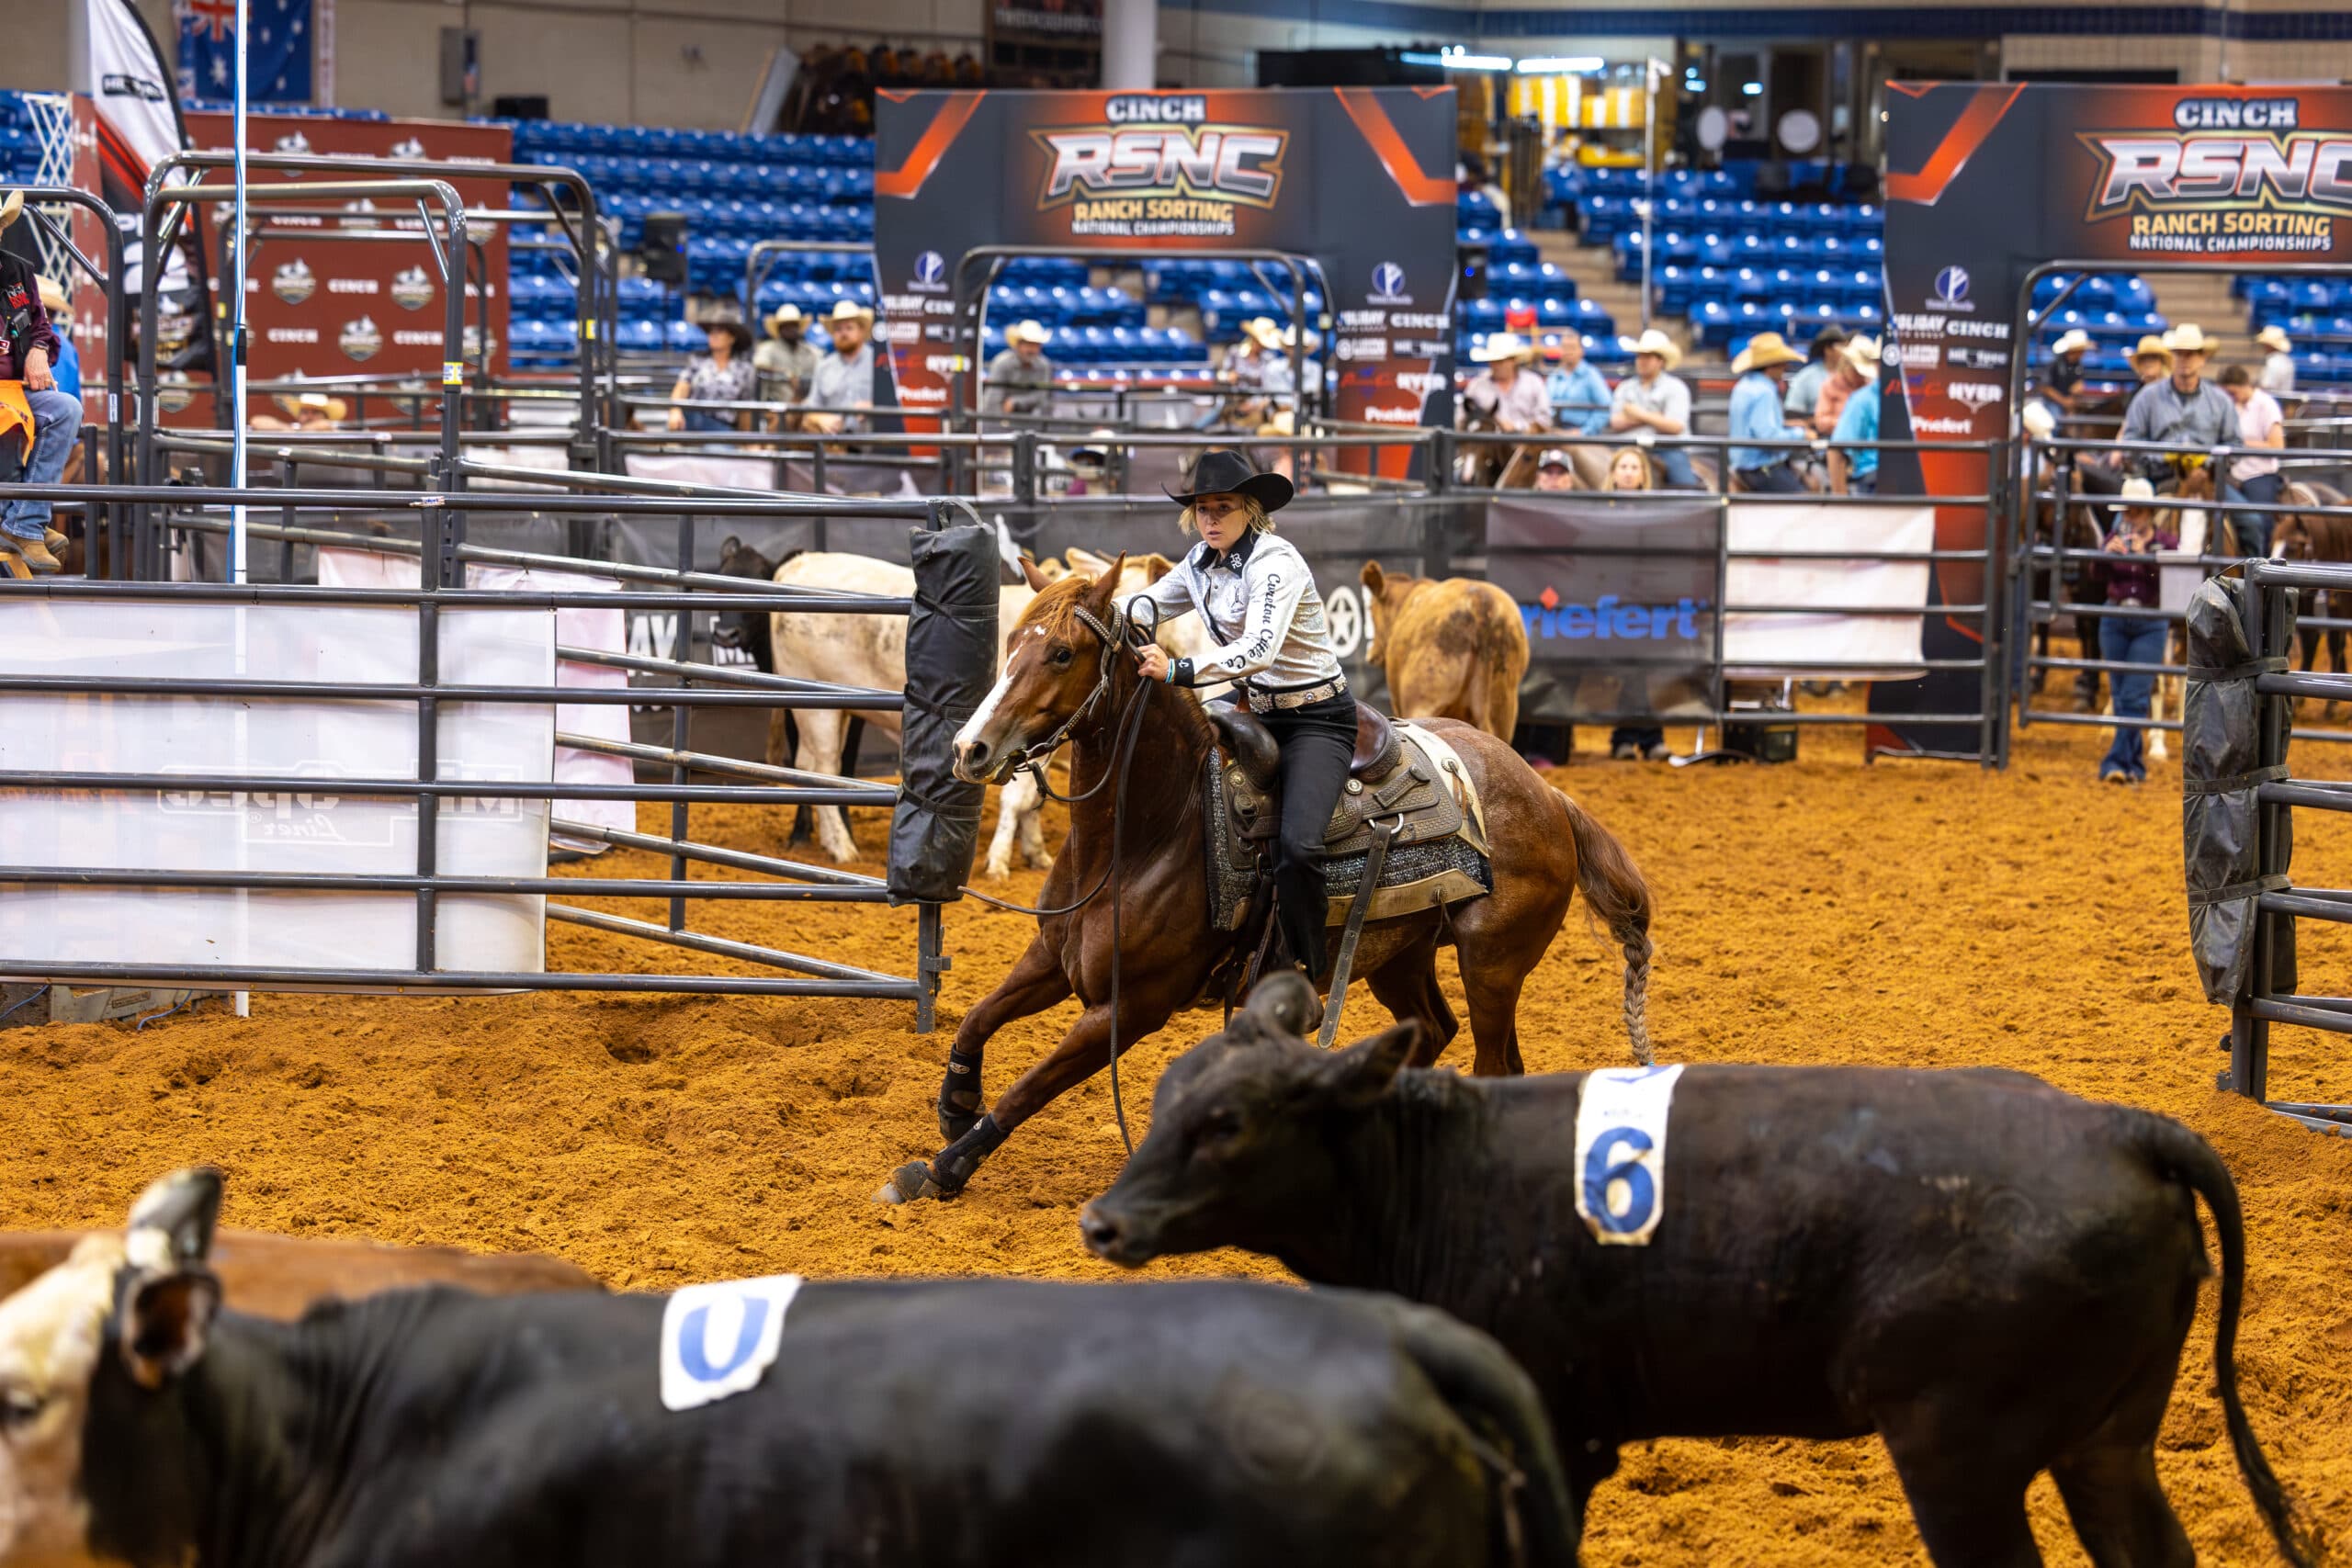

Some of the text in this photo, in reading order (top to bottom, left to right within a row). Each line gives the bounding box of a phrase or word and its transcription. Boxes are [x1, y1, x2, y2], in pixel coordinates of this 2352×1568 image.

[1105, 96, 1206, 122] CINCH
[2175, 100, 2297, 128] CINCH
[1046, 130, 1282, 197] RSNC
[1073, 198, 1235, 221] RANCH SORTING
[1071, 220, 1235, 236] NATIONAL CHAMPIONSHIPS
[2132, 212, 2331, 236] RANCH SORTING
[2129, 234, 2332, 252] NATIONAL CHAMPIONSHIPS
[1390, 312, 1451, 329] CINCH
[1947, 320, 2009, 339] CINCH
[1948, 382, 2003, 402] HYER
[1911, 415, 1972, 434] Priefert
[1521, 587, 1702, 641] riefert
[1585, 1126, 1654, 1233] 6
